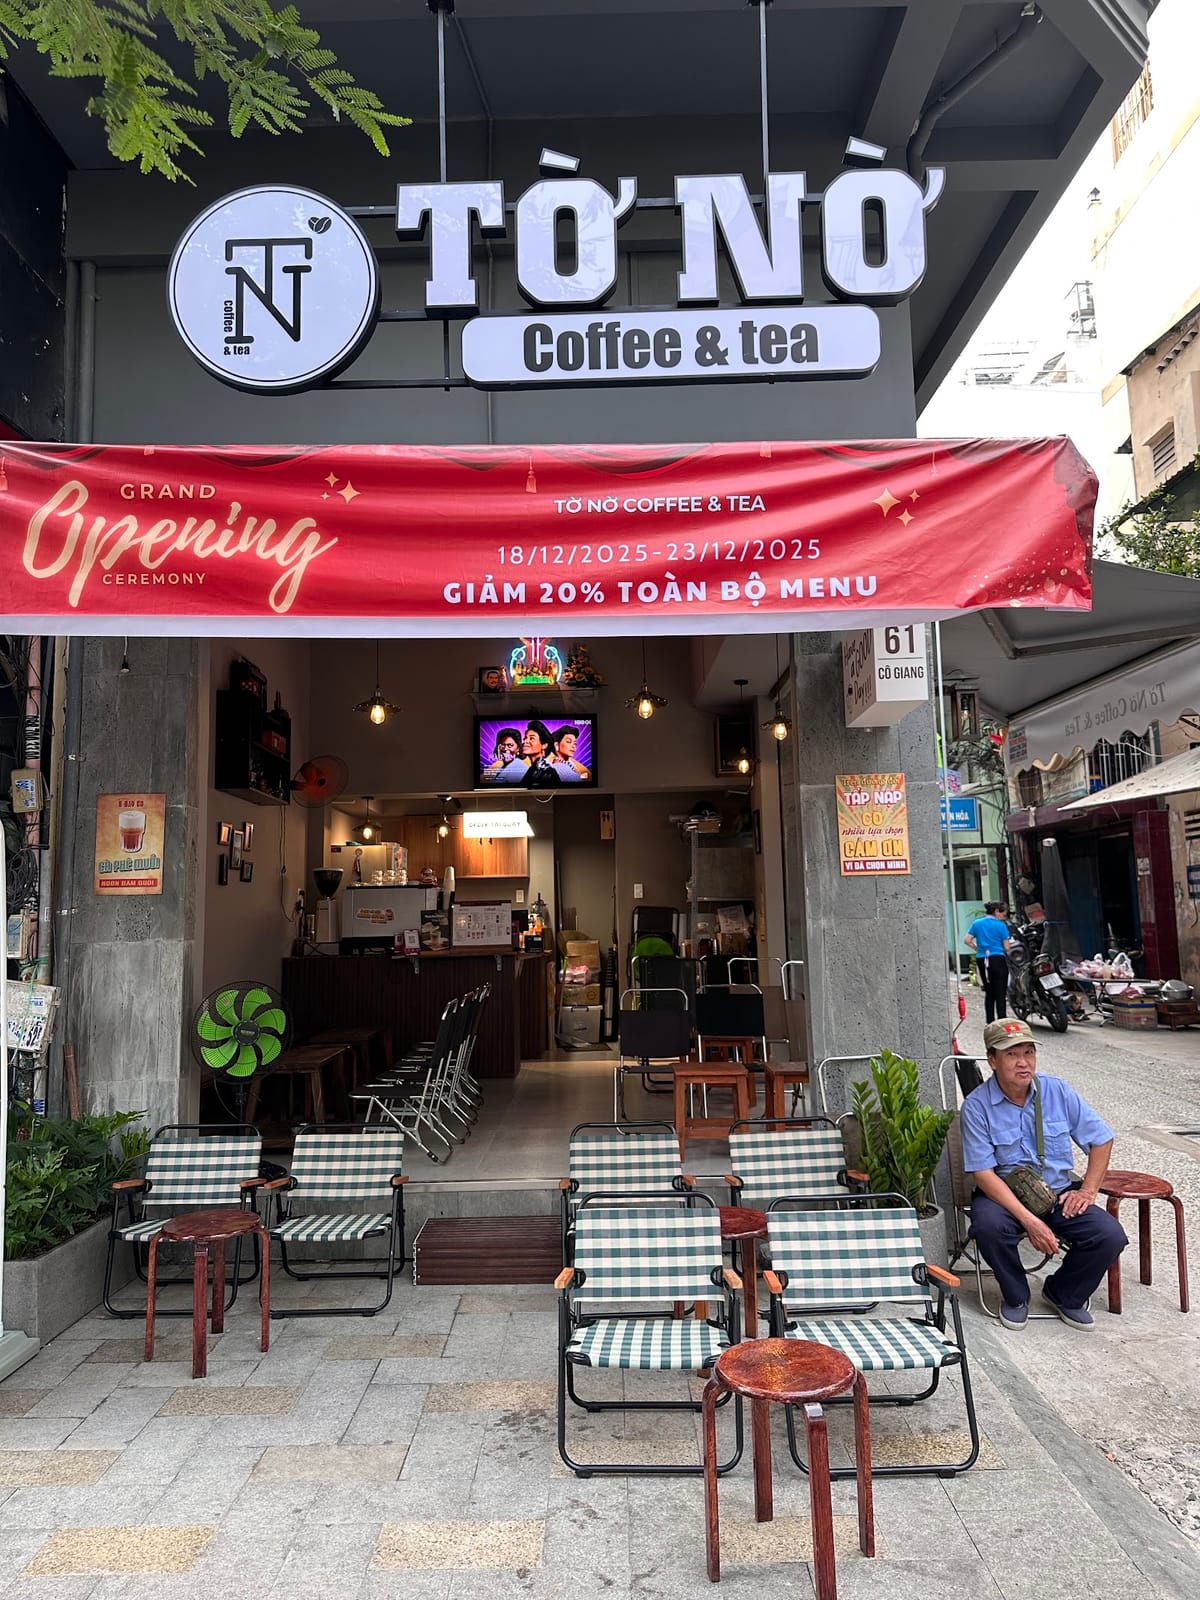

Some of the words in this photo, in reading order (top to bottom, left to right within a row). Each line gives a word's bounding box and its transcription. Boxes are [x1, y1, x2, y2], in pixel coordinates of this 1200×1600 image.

[396, 147, 638, 310] TỜ
[674, 136, 946, 304] NỜ
[223, 299, 235, 333] coffee
[223, 346, 232, 356] &
[233, 345, 251, 356] tea
[523, 321, 682, 373] Coffee
[694, 325, 730, 367] &
[739, 320, 819, 365] tea
[120, 483, 217, 499] GRAND
[554, 496, 581, 514] TỜ
[587, 496, 619, 514] NỜ
[623, 496, 703, 513] COFFEE
[707, 495, 722, 512] &
[726, 494, 766, 512] TEA
[22, 479, 339, 614] Opening
[102, 573, 206, 586] CEREMONY
[443, 574, 526, 604] GIẢM
[539, 582, 605, 604] 20%
[618, 571, 707, 604] TOÀN
[720, 571, 767, 607] BỘ
[780, 575, 877, 599] MENU
[885, 625, 915, 654] 61
[878, 665, 892, 680] CÔ
[894, 666, 925, 679] GIANG
